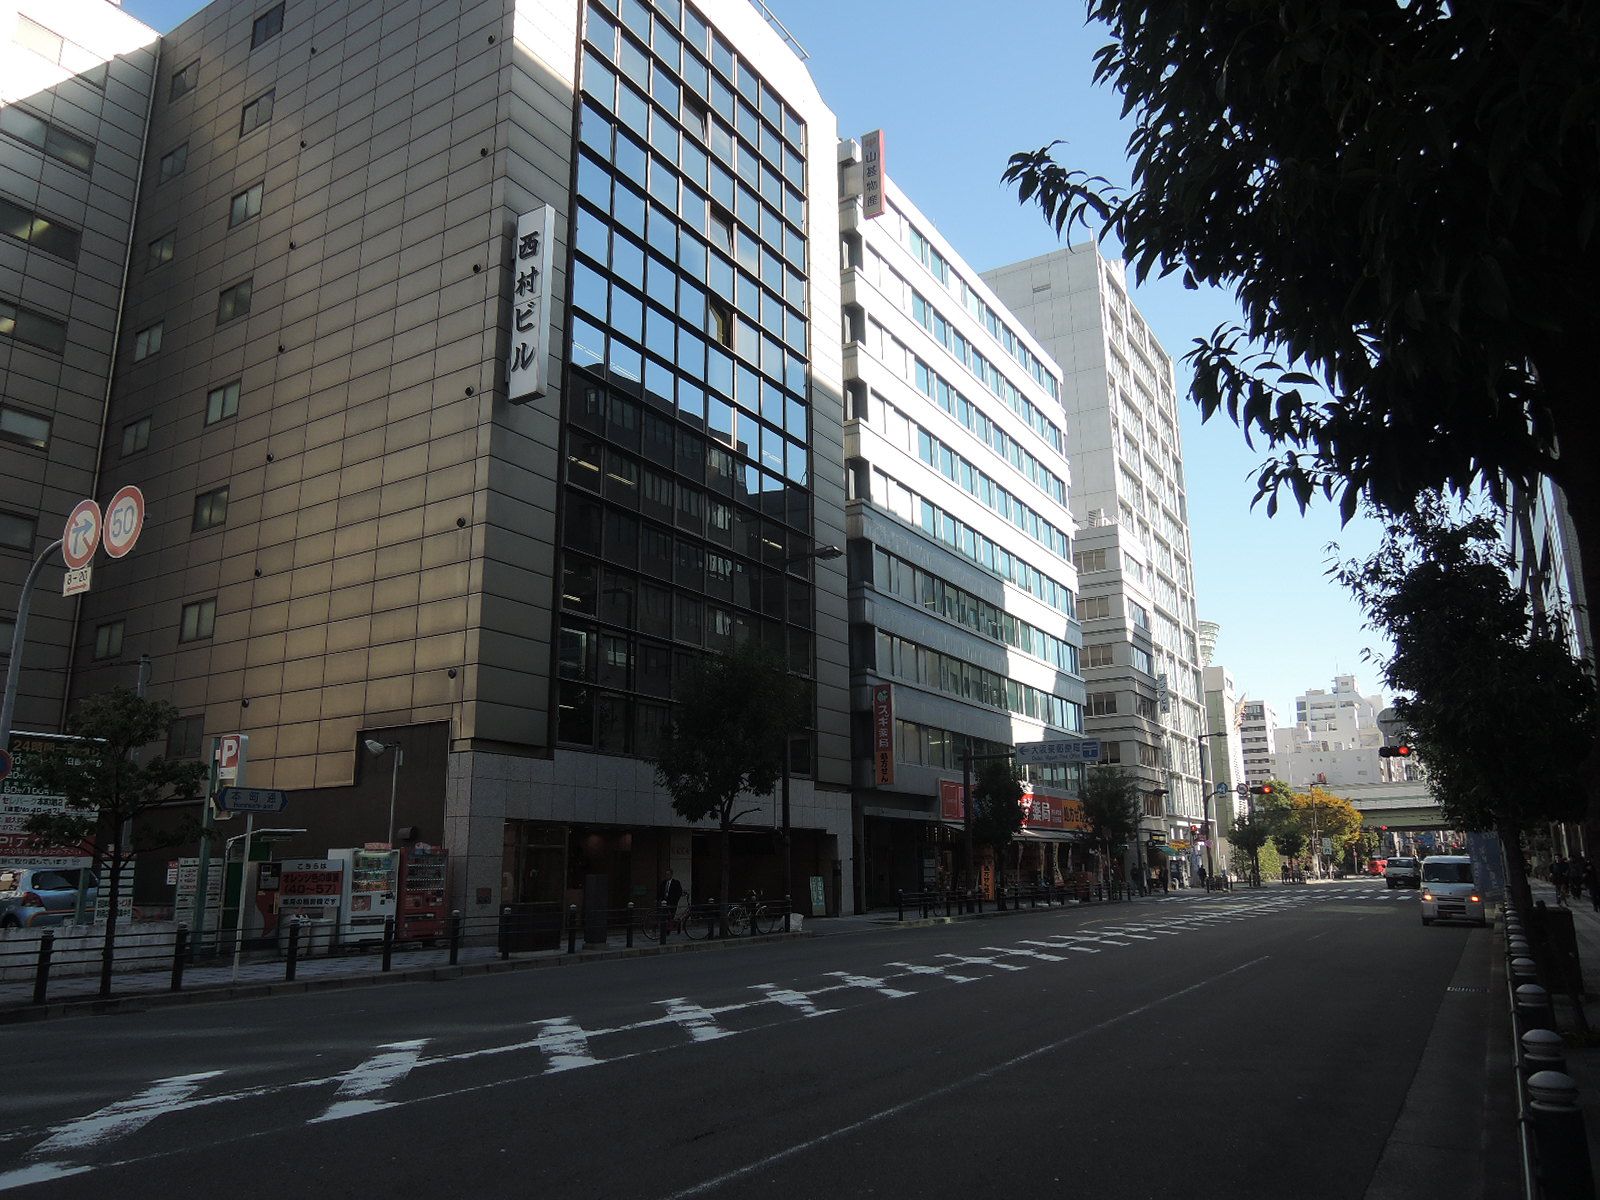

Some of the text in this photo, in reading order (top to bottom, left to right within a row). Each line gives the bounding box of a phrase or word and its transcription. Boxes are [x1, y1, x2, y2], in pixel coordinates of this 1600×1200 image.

[511, 231, 540, 373] 西村ビル
[112, 505, 135, 538] 50
[878, 704, 890, 748] スギ薬局
[221, 739, 238, 767] P
[880, 752, 890, 783] 処方せん
[1032, 800, 1051, 822] 薬局
[297, 862, 328, 870] こちらは
